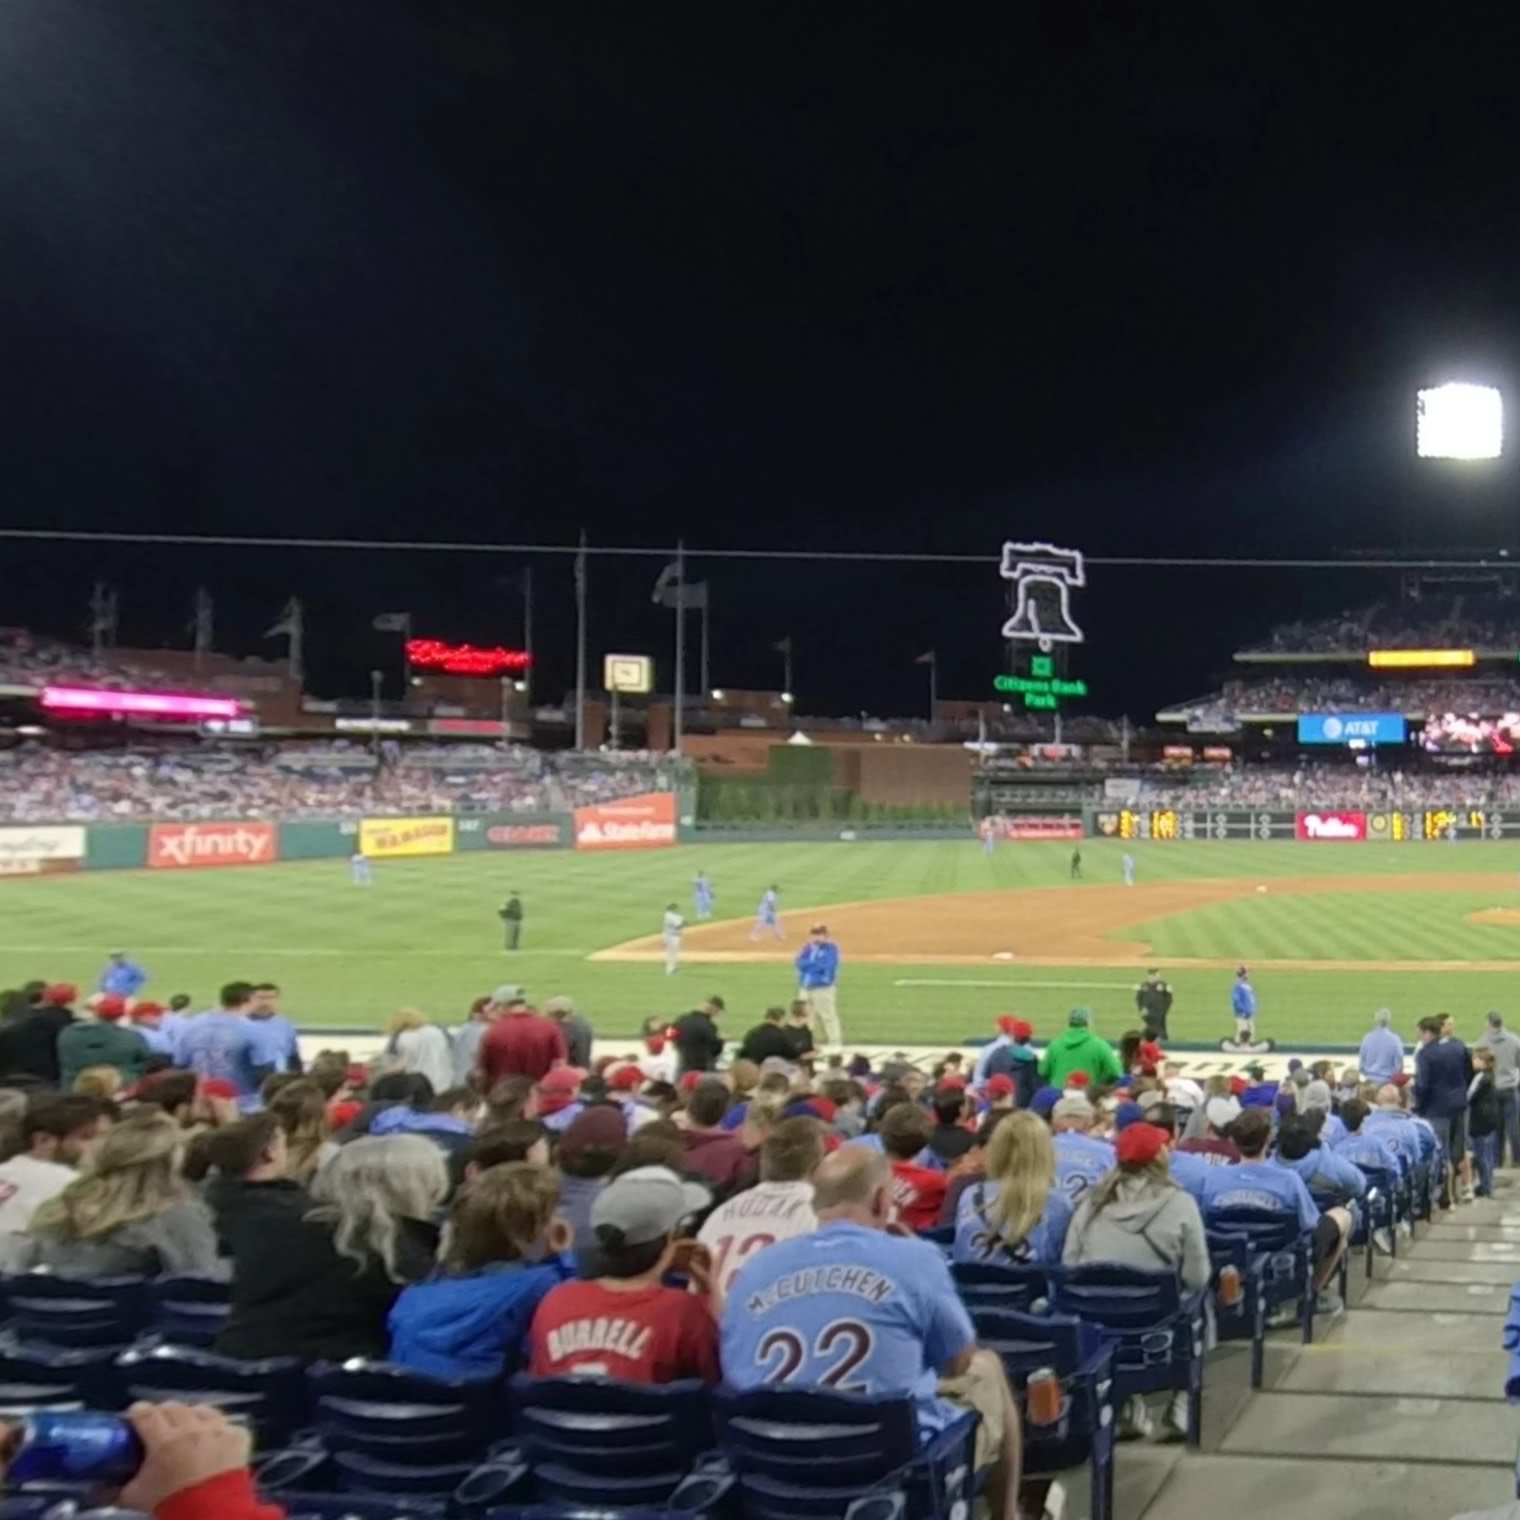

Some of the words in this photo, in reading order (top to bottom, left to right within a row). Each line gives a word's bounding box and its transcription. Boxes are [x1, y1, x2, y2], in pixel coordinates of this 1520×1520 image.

[1024, 692, 1056, 709] Park
[1051, 678, 1087, 696] Bank
[1344, 720, 1379, 736] AT&T
[159, 827, 269, 864] xfinity
[546, 1317, 654, 1363] BURRELL
[754, 1316, 875, 1392] 22
